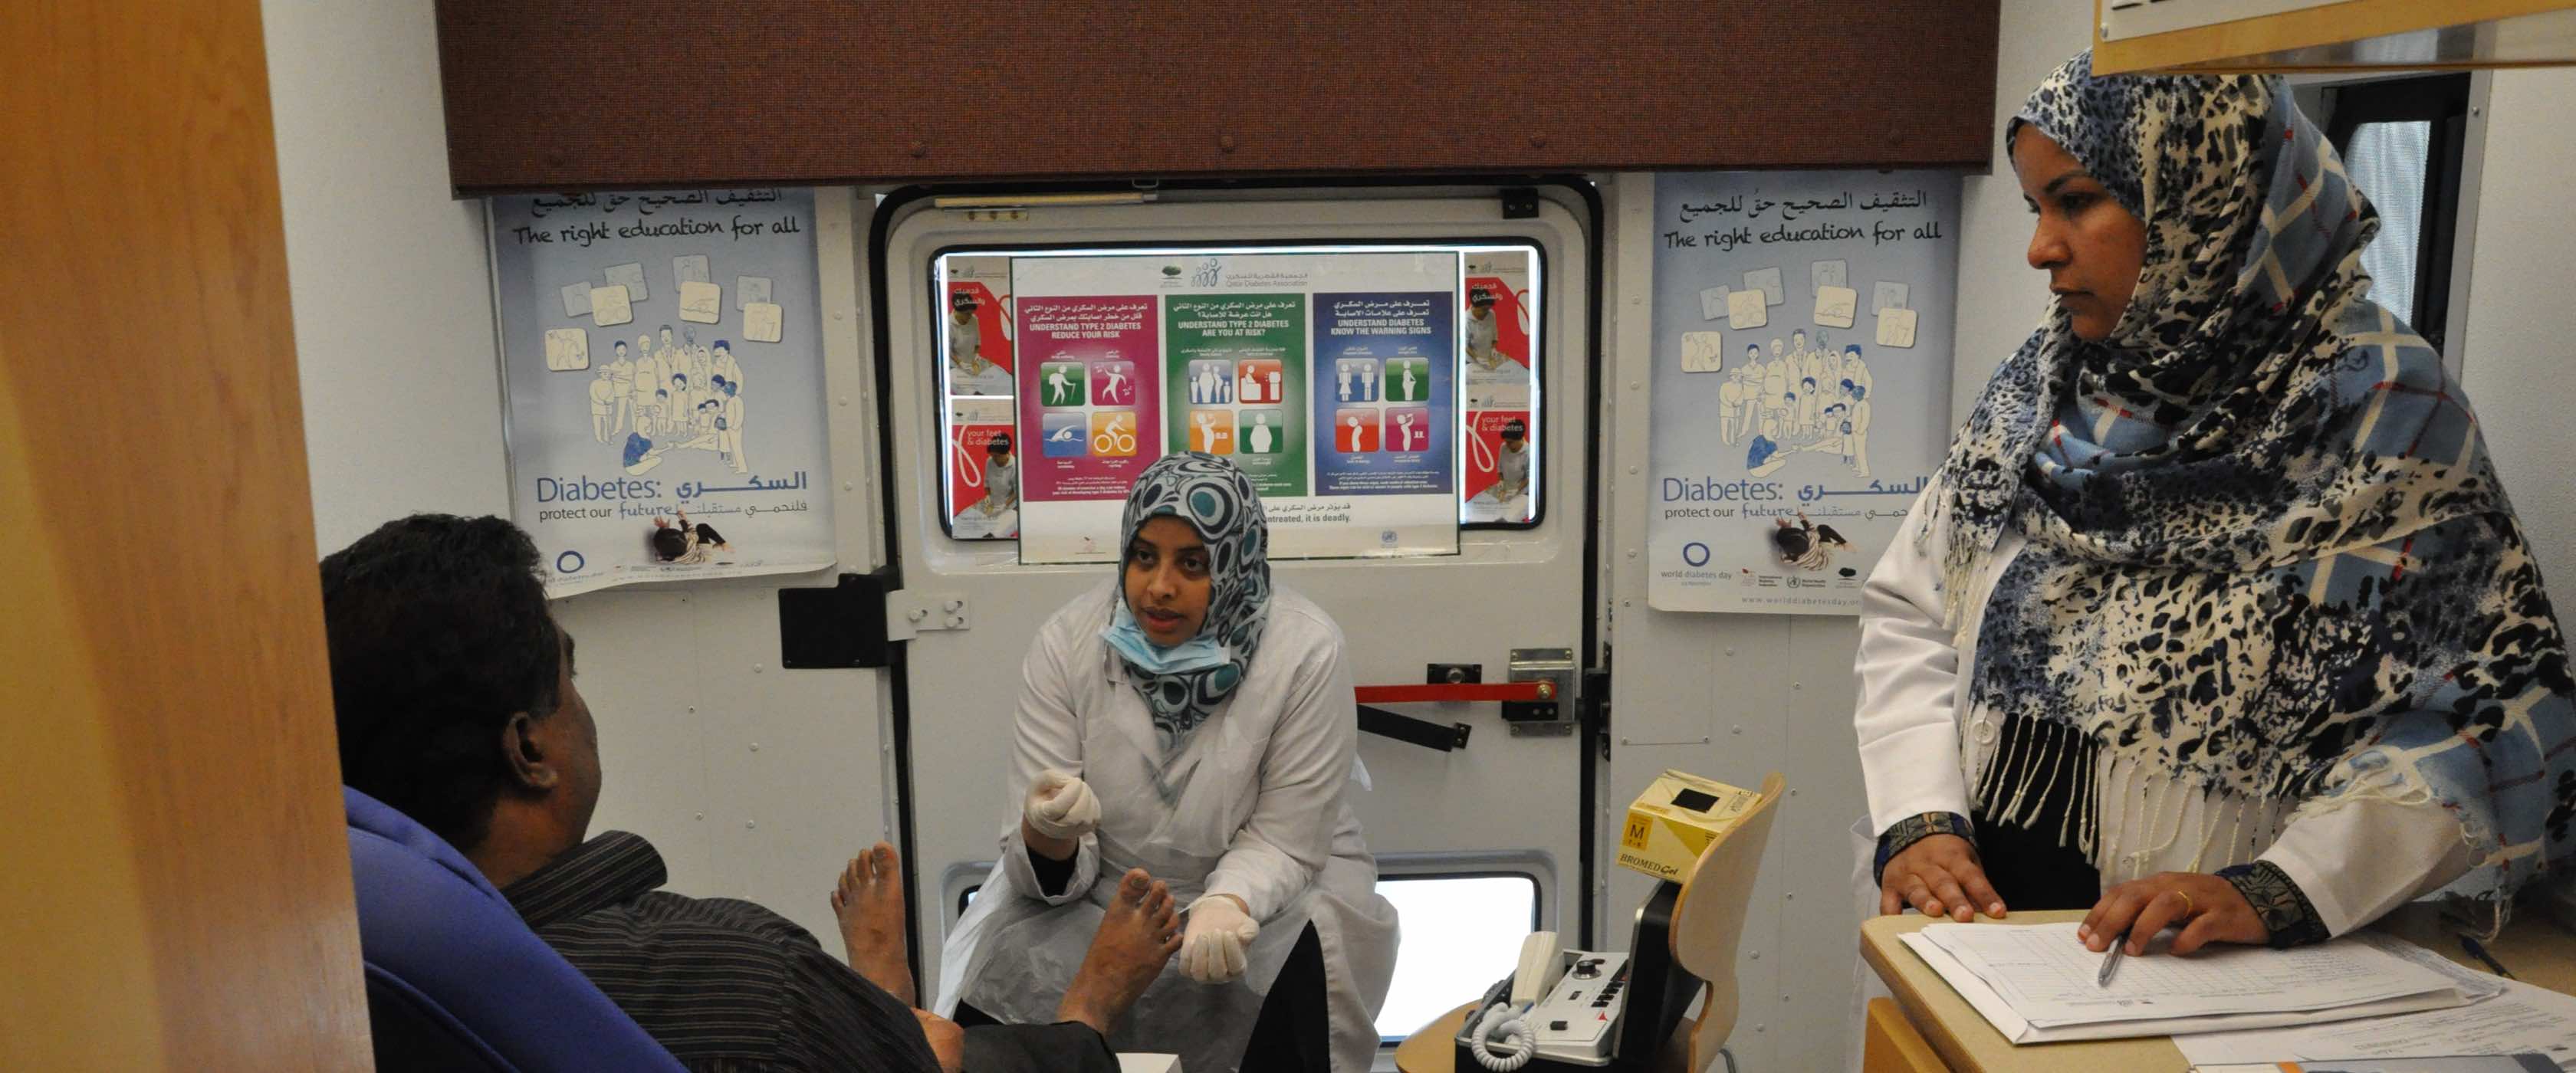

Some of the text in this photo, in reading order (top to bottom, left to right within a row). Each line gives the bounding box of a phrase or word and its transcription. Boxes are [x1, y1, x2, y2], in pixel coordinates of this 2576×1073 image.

[1678, 194, 1743, 224] للجميع
[1782, 191, 1854, 221] الصحيح
[1859, 190, 1927, 212] التثقيف
[512, 215, 800, 248] The right education for all
[1663, 220, 1943, 252] The right education for all
[1030, 323, 1079, 331] UNDERSTAND
[1081, 323, 1099, 331] TYPE
[1106, 322, 1141, 330] DIABETES
[1254, 320, 1289, 328] DIABETES
[1338, 318, 1424, 327] UNDERSTAND DIABETES
[536, 474, 662, 504] Diabetes:
[1663, 476, 1784, 502] Diabetes:
[539, 500, 673, 523] protect our future
[1322, 514, 1351, 523] deadly.
[1664, 502, 1794, 520] protect our future
[1661, 569, 1732, 580] world diabetes day
[1629, 824, 1645, 841] M
